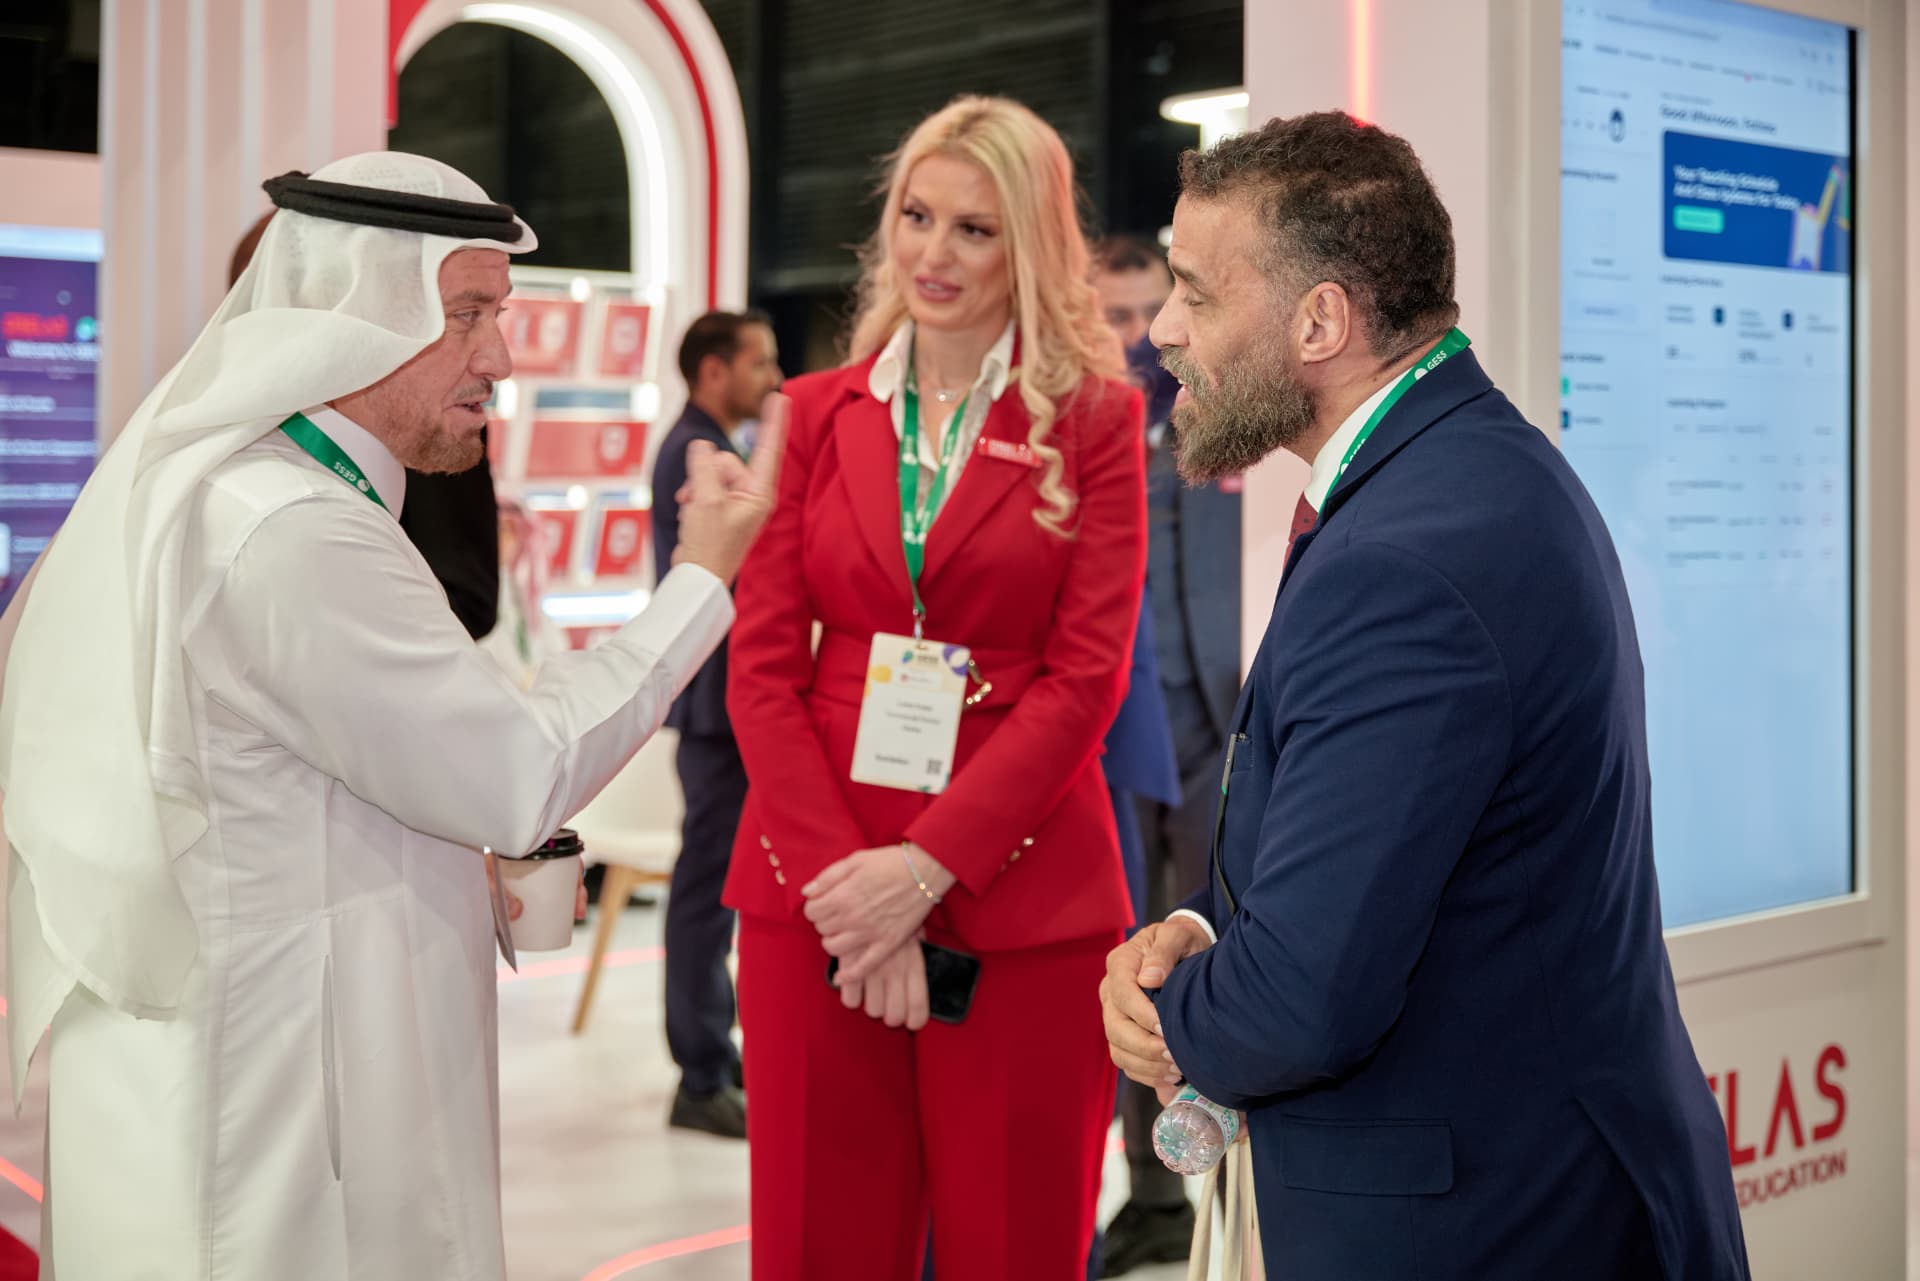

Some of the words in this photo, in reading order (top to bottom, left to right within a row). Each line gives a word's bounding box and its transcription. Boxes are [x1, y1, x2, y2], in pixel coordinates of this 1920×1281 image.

[1427, 350, 1448, 370] GESS
[335, 461, 356, 481] GESS
[1706, 1043, 1847, 1167] LAS
